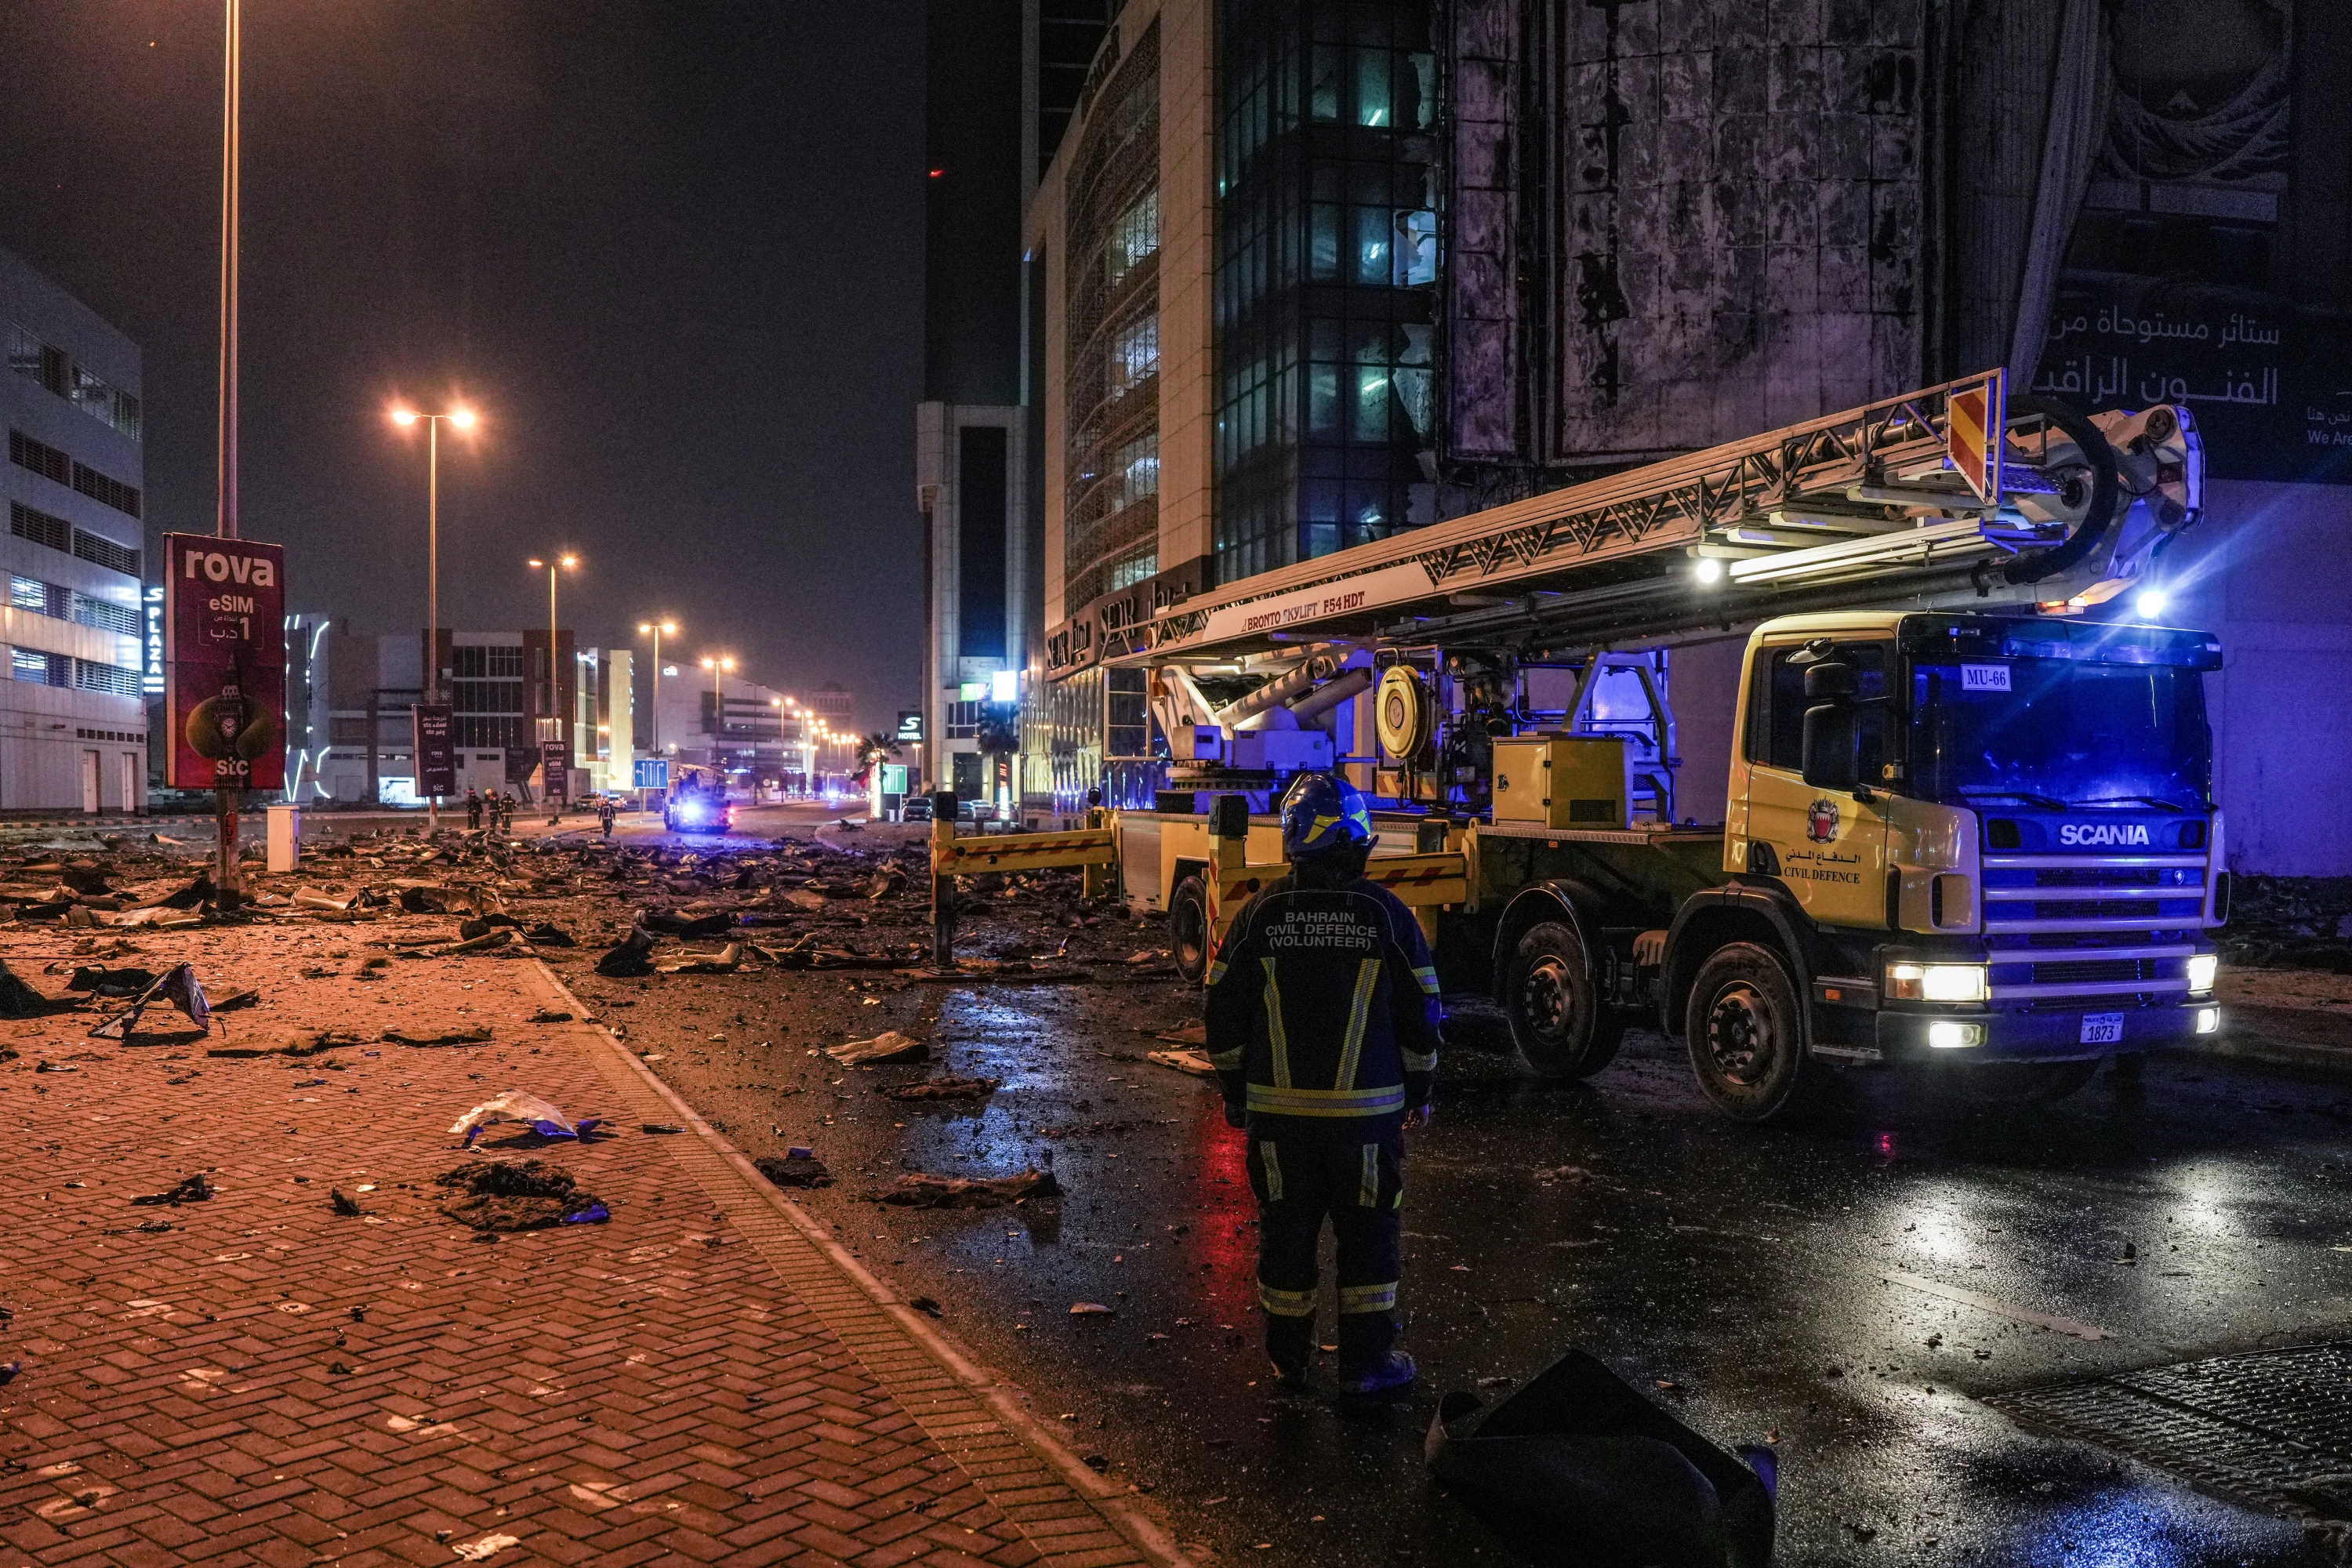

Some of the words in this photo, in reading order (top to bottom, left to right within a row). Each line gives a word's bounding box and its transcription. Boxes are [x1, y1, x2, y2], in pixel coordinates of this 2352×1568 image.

[2097, 305, 2209, 343] مستوحاة
[2218, 314, 2279, 349] ستائر
[2031, 355, 2128, 404] الراقي
[2307, 429, 2329, 445] We
[185, 550, 274, 587] rova
[209, 593, 254, 614] eSIM
[1247, 610, 1281, 631] BRONTO
[1283, 601, 1318, 623] SKYLIFT
[239, 616, 249, 640] 1
[148, 607, 162, 674] PLAZA
[1966, 669, 2006, 686] MU-66
[216, 756, 249, 776] stc
[433, 783, 444, 792] stc
[2060, 824, 2150, 846] SCANIA
[1784, 866, 1810, 880] CIVIL
[1812, 869, 1860, 884] DEFENCE
[1284, 912, 1356, 924] BAHRAIN
[1265, 924, 1301, 937] CIVIL
[1304, 924, 1378, 938] DEFENCE
[1269, 935, 1372, 952] (VOLUNTEER)
[2087, 1025, 2115, 1041] 1873
